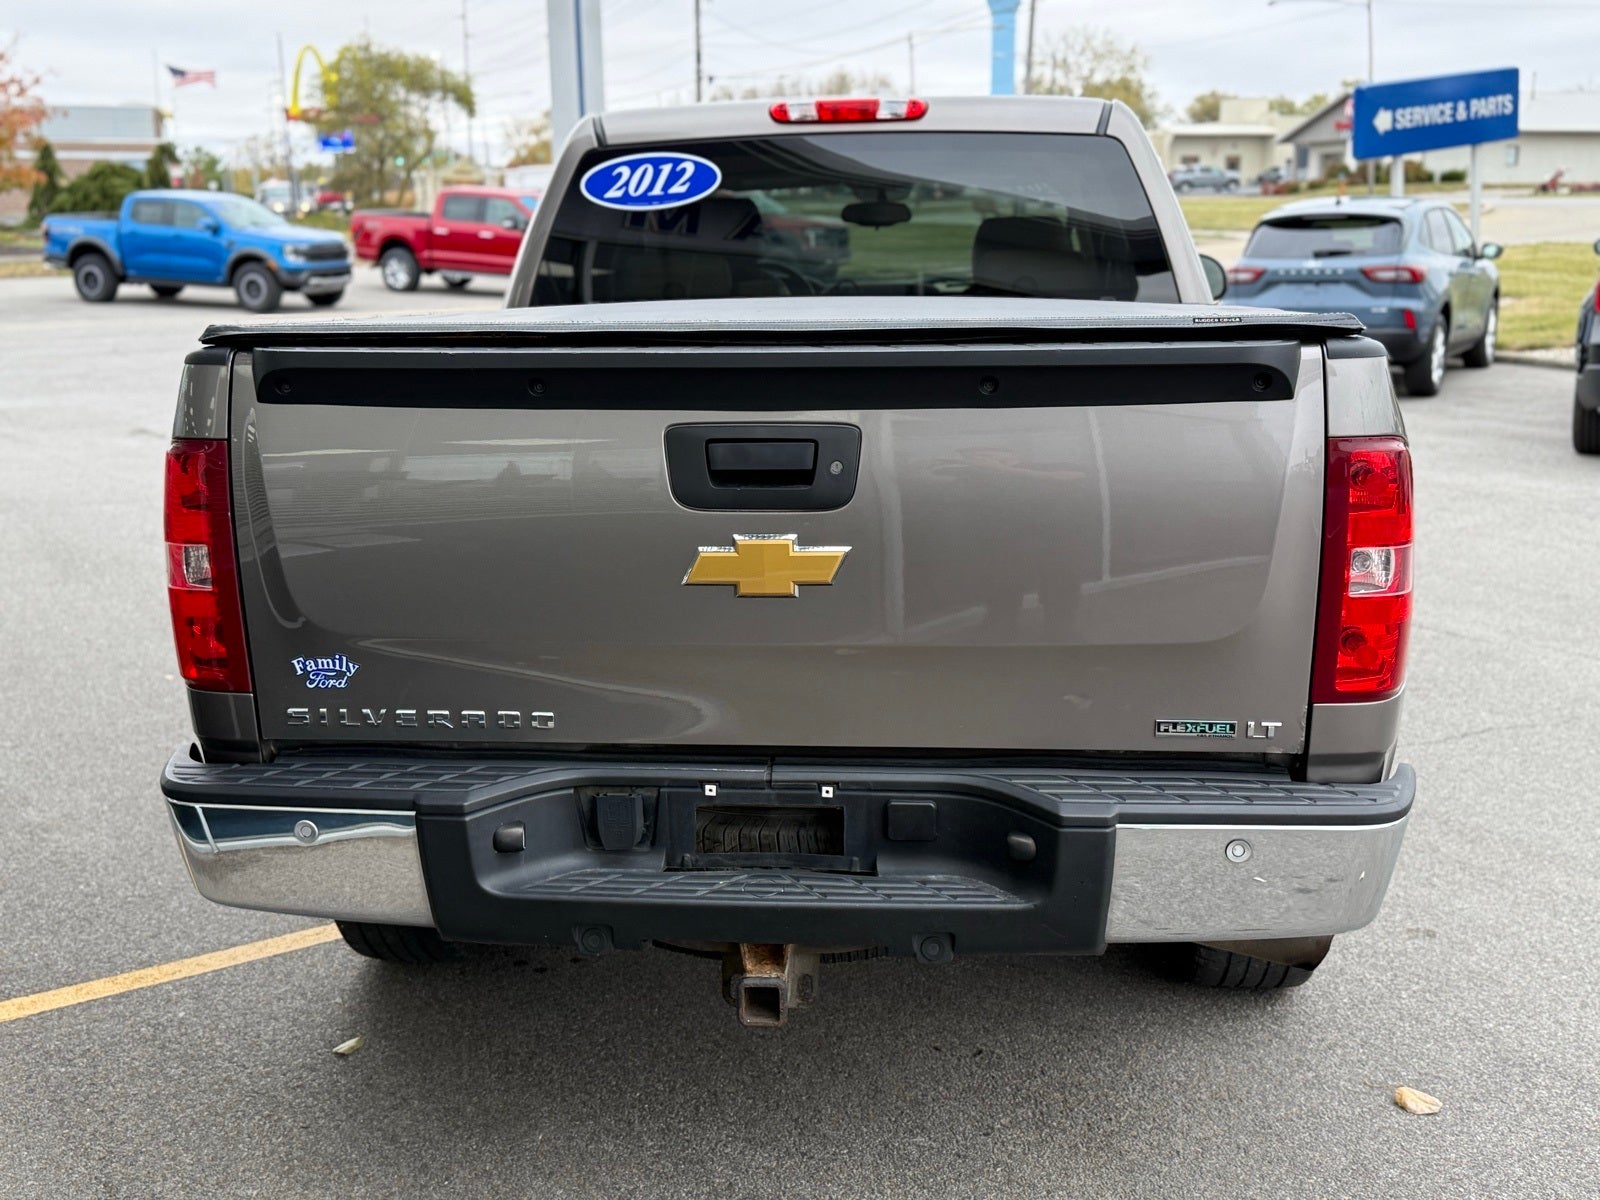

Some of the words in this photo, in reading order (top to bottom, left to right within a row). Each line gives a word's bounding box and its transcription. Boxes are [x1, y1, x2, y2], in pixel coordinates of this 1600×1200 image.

[1394, 102, 1454, 131] SERVICE
[1456, 99, 1469, 122] &
[1469, 93, 1514, 121] PARTS
[603, 160, 695, 198] 2012
[291, 654, 360, 677] Family
[305, 670, 348, 689] Ford
[286, 707, 556, 729] SILVERADO
[1159, 722, 1235, 734] FLEXFUEL
[1246, 721, 1283, 738] LT
